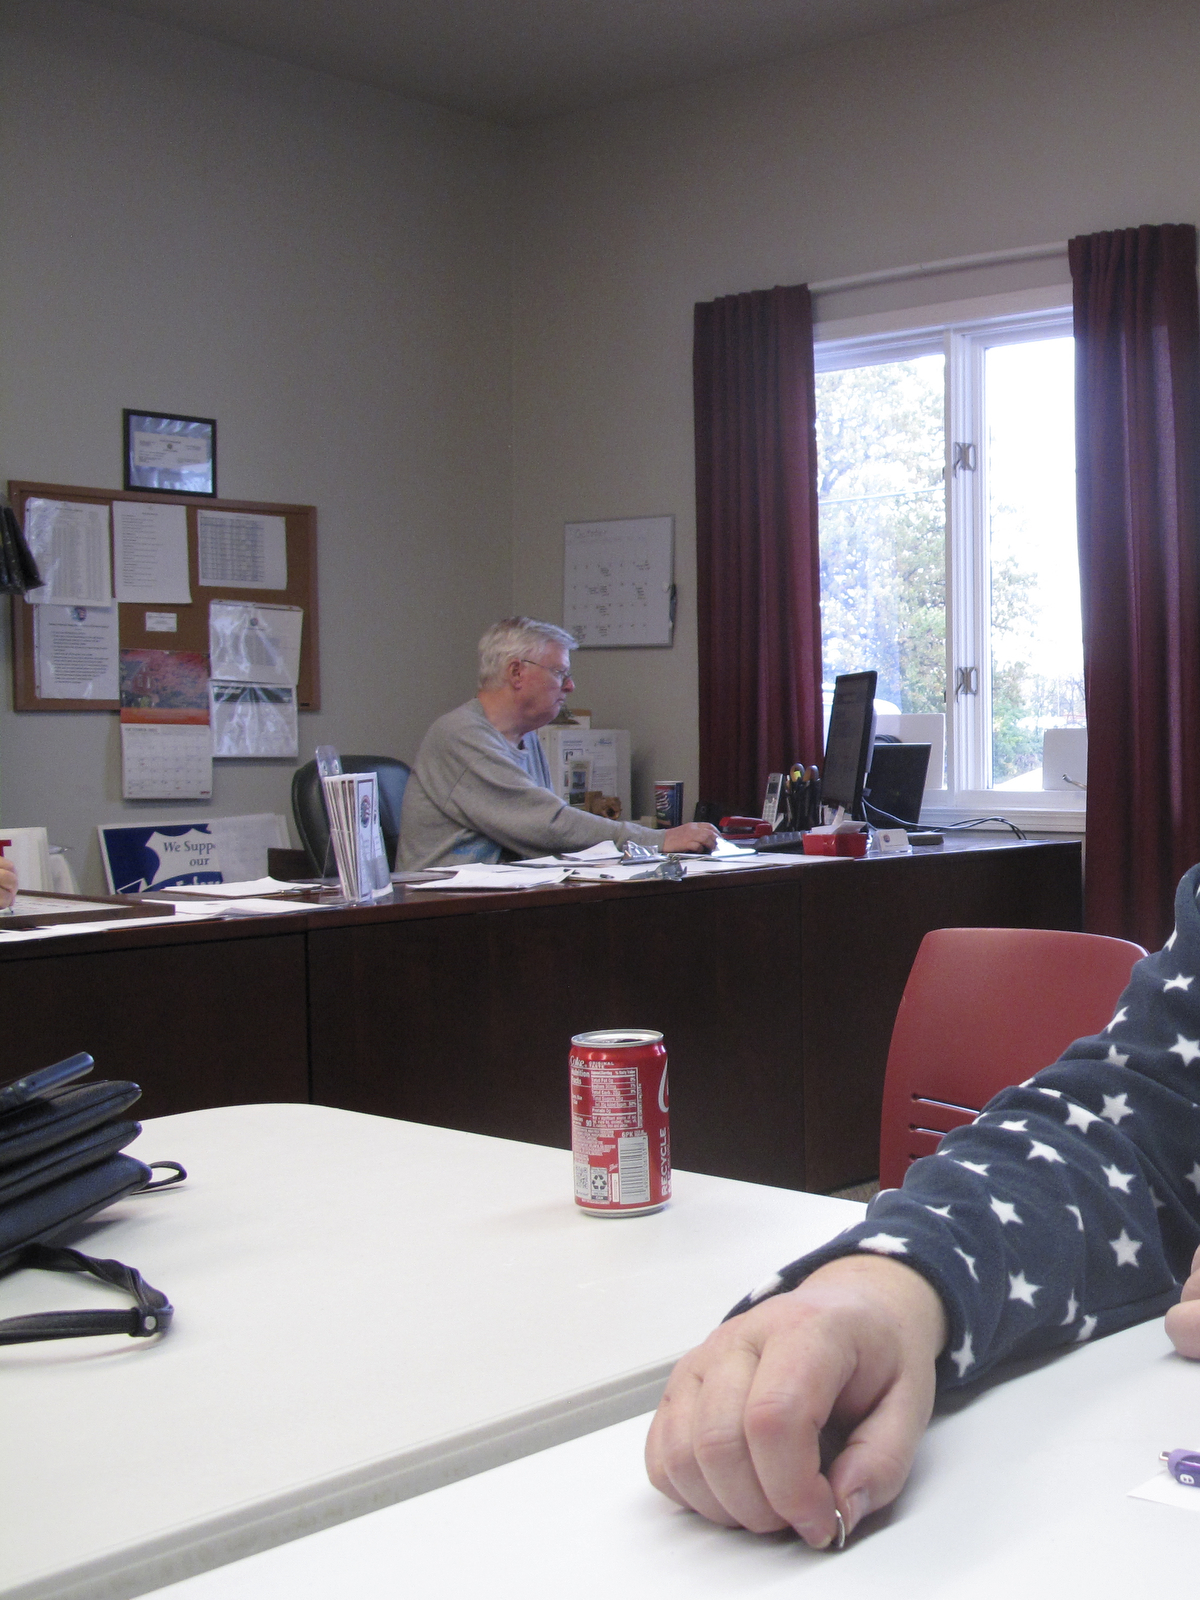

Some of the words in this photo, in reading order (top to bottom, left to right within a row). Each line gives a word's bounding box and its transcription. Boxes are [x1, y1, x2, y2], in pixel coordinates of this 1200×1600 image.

[163, 841, 181, 853] We
[189, 856, 209, 867] our
[569, 1055, 585, 1067] Coke
[659, 1127, 669, 1196] RECYCLE
